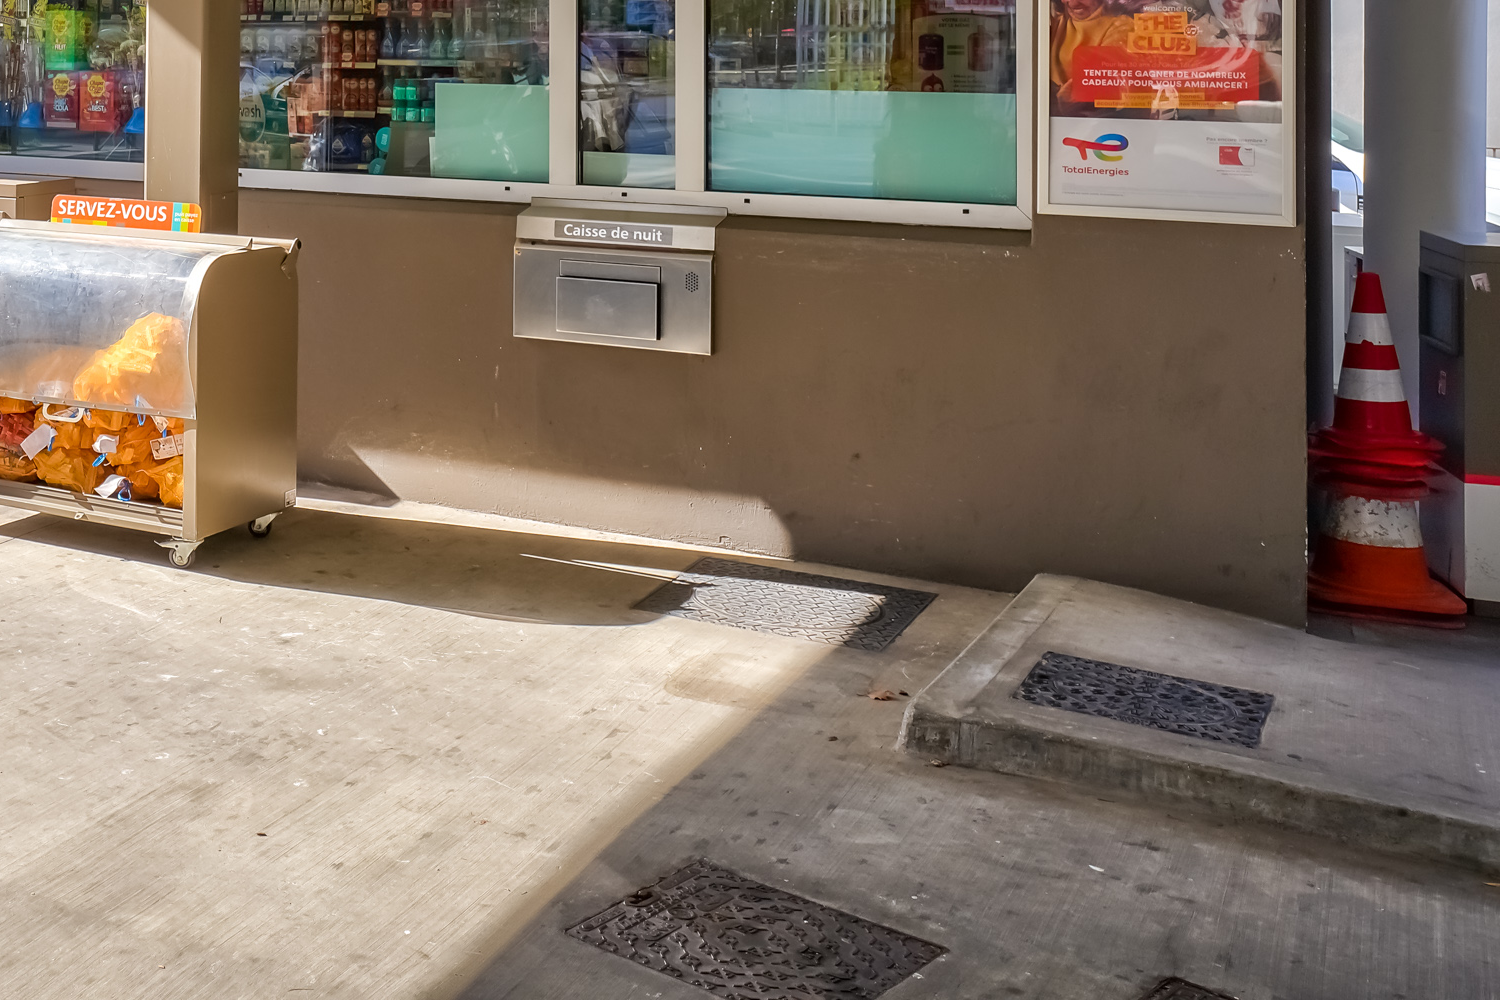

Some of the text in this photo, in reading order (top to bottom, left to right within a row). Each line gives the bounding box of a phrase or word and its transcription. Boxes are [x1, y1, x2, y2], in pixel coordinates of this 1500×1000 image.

[1140, 15, 1183, 30] THE
[1133, 36, 1191, 52] CLUB
[1083, 69, 1246, 80] TENTEZ DE GAGNER DE NOMBREUX
[89, 79, 105, 87] Chupa
[1081, 78, 1126, 87] CADEAUX
[1128, 79, 1154, 87] POUR
[1155, 80, 1182, 88] VOUS
[1184, 81, 1242, 89] AMBIANCER
[1062, 165, 1129, 177] TotalEnergies
[58, 199, 167, 222] SERVEZ-VOUS
[563, 223, 662, 242] Caisse de nuit
